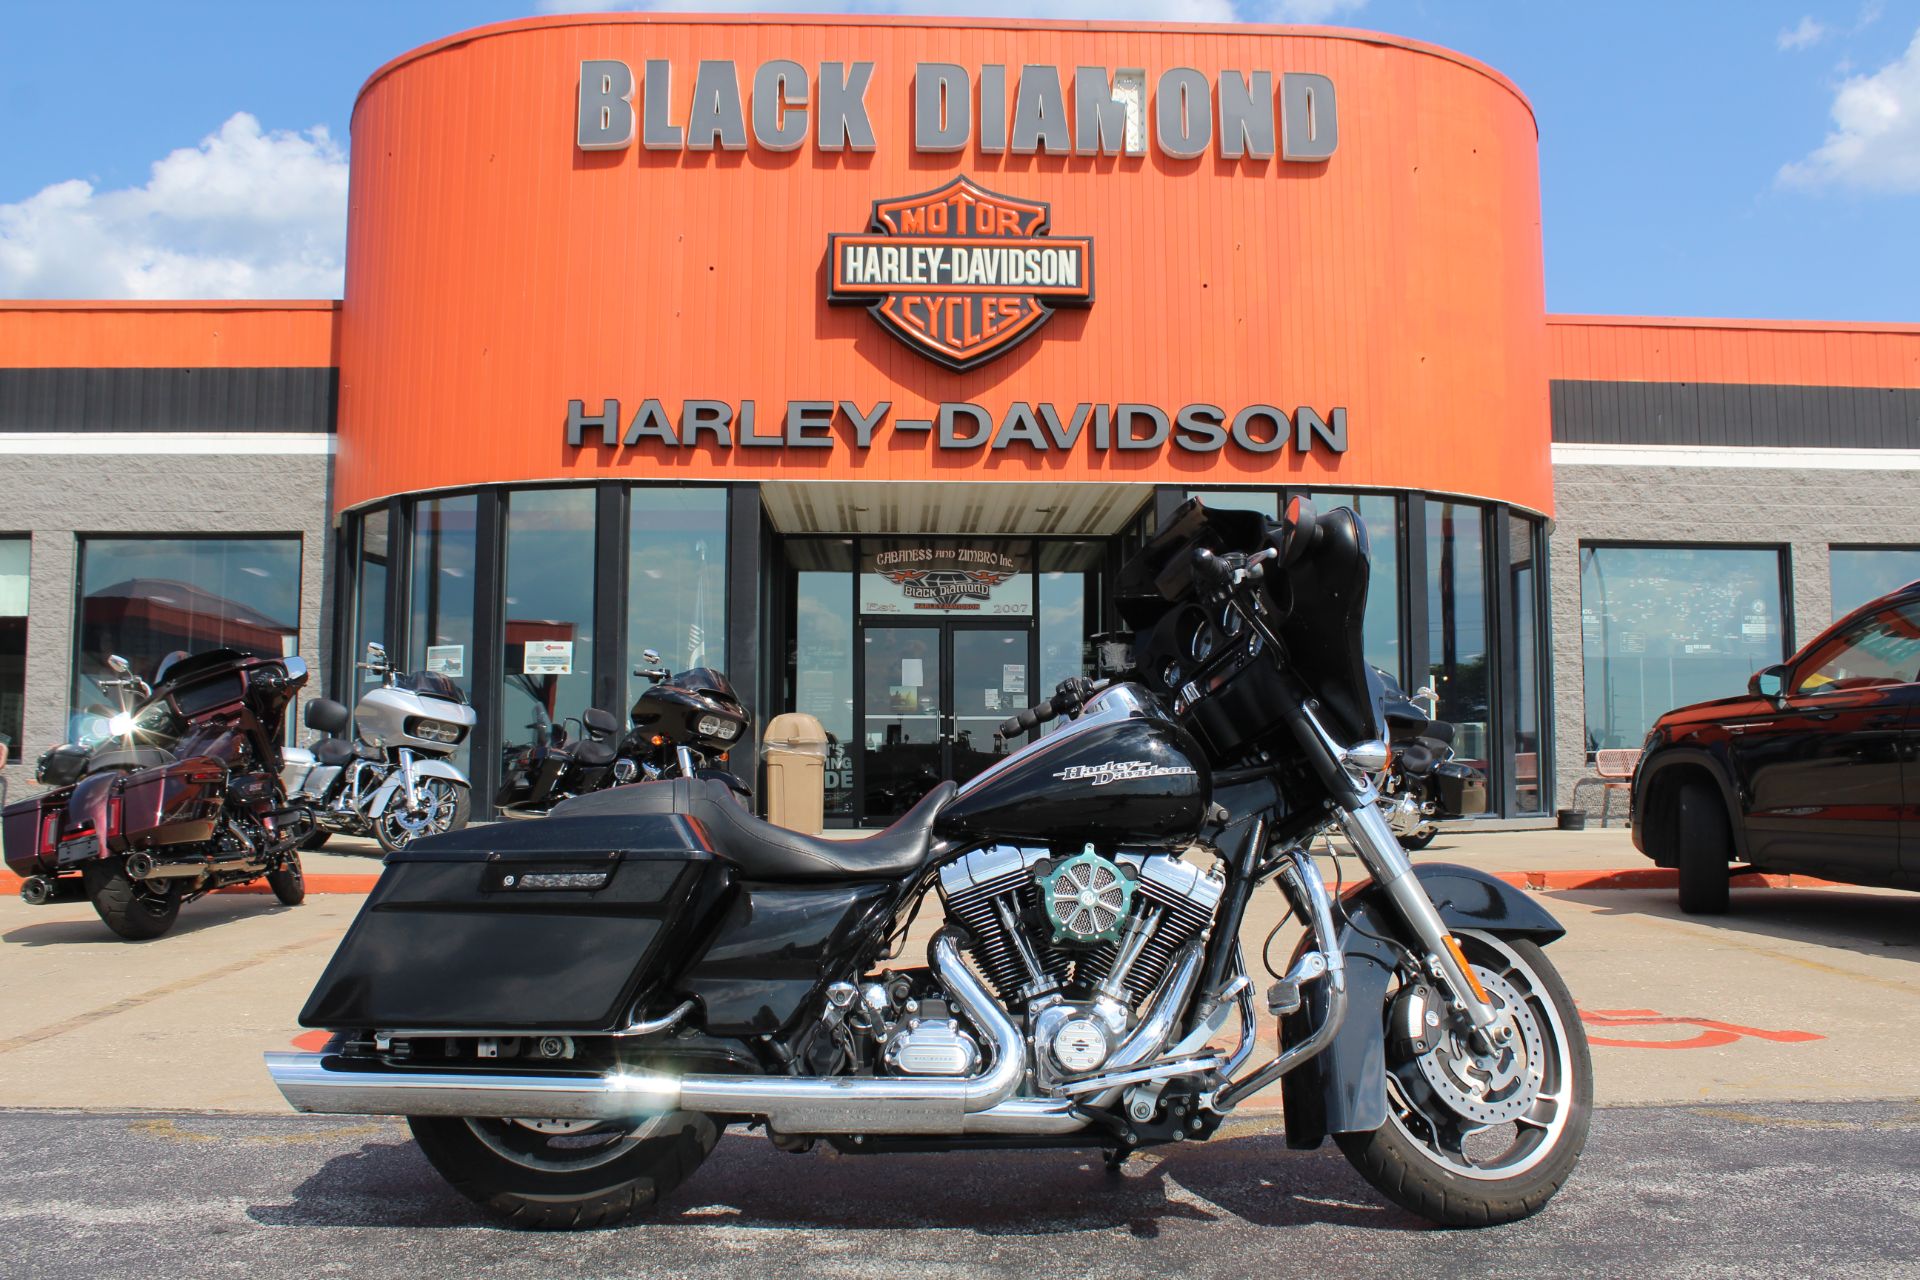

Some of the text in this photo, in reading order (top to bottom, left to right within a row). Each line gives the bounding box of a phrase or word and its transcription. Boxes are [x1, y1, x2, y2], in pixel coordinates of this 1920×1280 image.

[577, 59, 1340, 162] BLACK DIAMOND
[900, 191, 1023, 237] MOTOR
[845, 245, 1078, 287] HARLEY-DAVIDSON
[901, 295, 1022, 349] CYCLES
[565, 398, 1348, 454] HARLEY-DAVIDSON
[876, 548, 933, 566] CABANESS
[957, 548, 998, 565] ZIMBRO
[993, 604, 1028, 614] 2007
